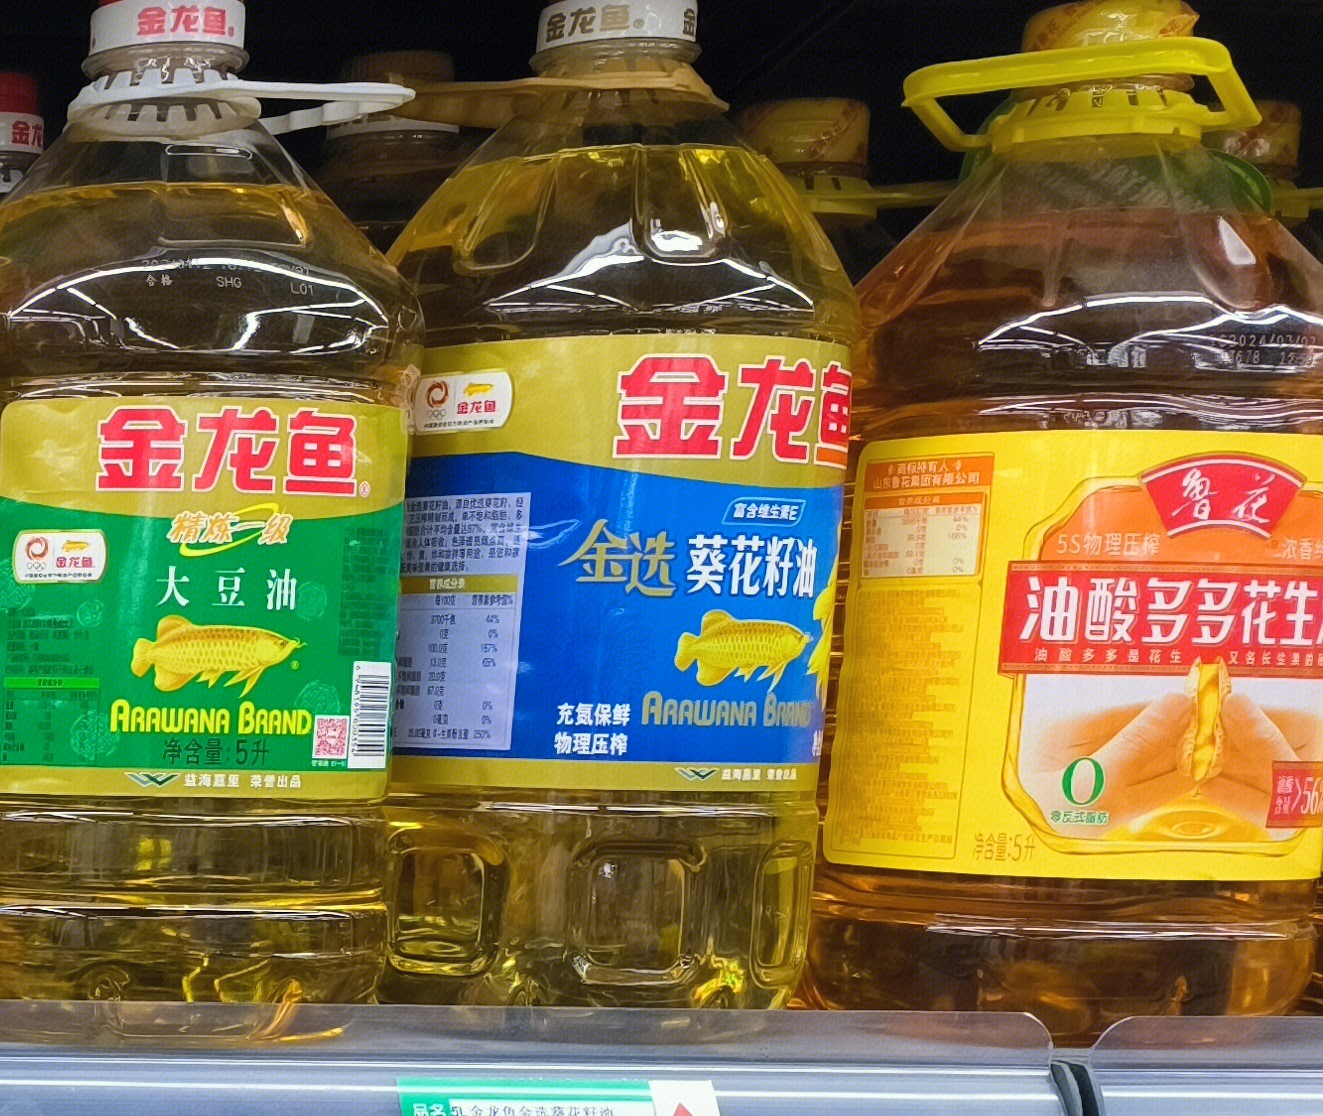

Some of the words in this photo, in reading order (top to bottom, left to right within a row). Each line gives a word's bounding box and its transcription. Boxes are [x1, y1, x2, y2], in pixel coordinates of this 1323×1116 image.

[137, 7, 227, 36] 金龙鱼
[546, 4, 630, 43] 金龙鱼
[613, 353, 852, 469] 金龙鱼
[96, 404, 357, 497] 金龙鱼
[873, 472, 980, 490] 山东鲁花集团有限公司
[1171, 470, 1271, 523] 鲁花
[167, 511, 294, 544] 精炼一级
[1057, 533, 1160, 556] 5S物理压榨
[57, 557, 94, 568] 金龙鱼
[558, 519, 676, 596] 金选
[687, 535, 817, 597] 葵花籽油
[157, 566, 297, 610] 大豆油
[1019, 576, 1323, 645] 油酸多多花生
[1034, 648, 1182, 664] 油酸多多是花生
[110, 699, 230, 733] ARAWANA
[238, 701, 312, 735] BRAND
[557, 702, 631, 725] 充氮保鲜
[642, 691, 757, 727] ARAWANA
[763, 692, 813, 729] BRAND
[162, 738, 269, 765] 净含量:5升
[555, 733, 628, 756] 物理压榨
[184, 773, 239, 788] 益海嘉里
[1062, 757, 1105, 806] 0
[972, 832, 1036, 862] 净含量:5升
